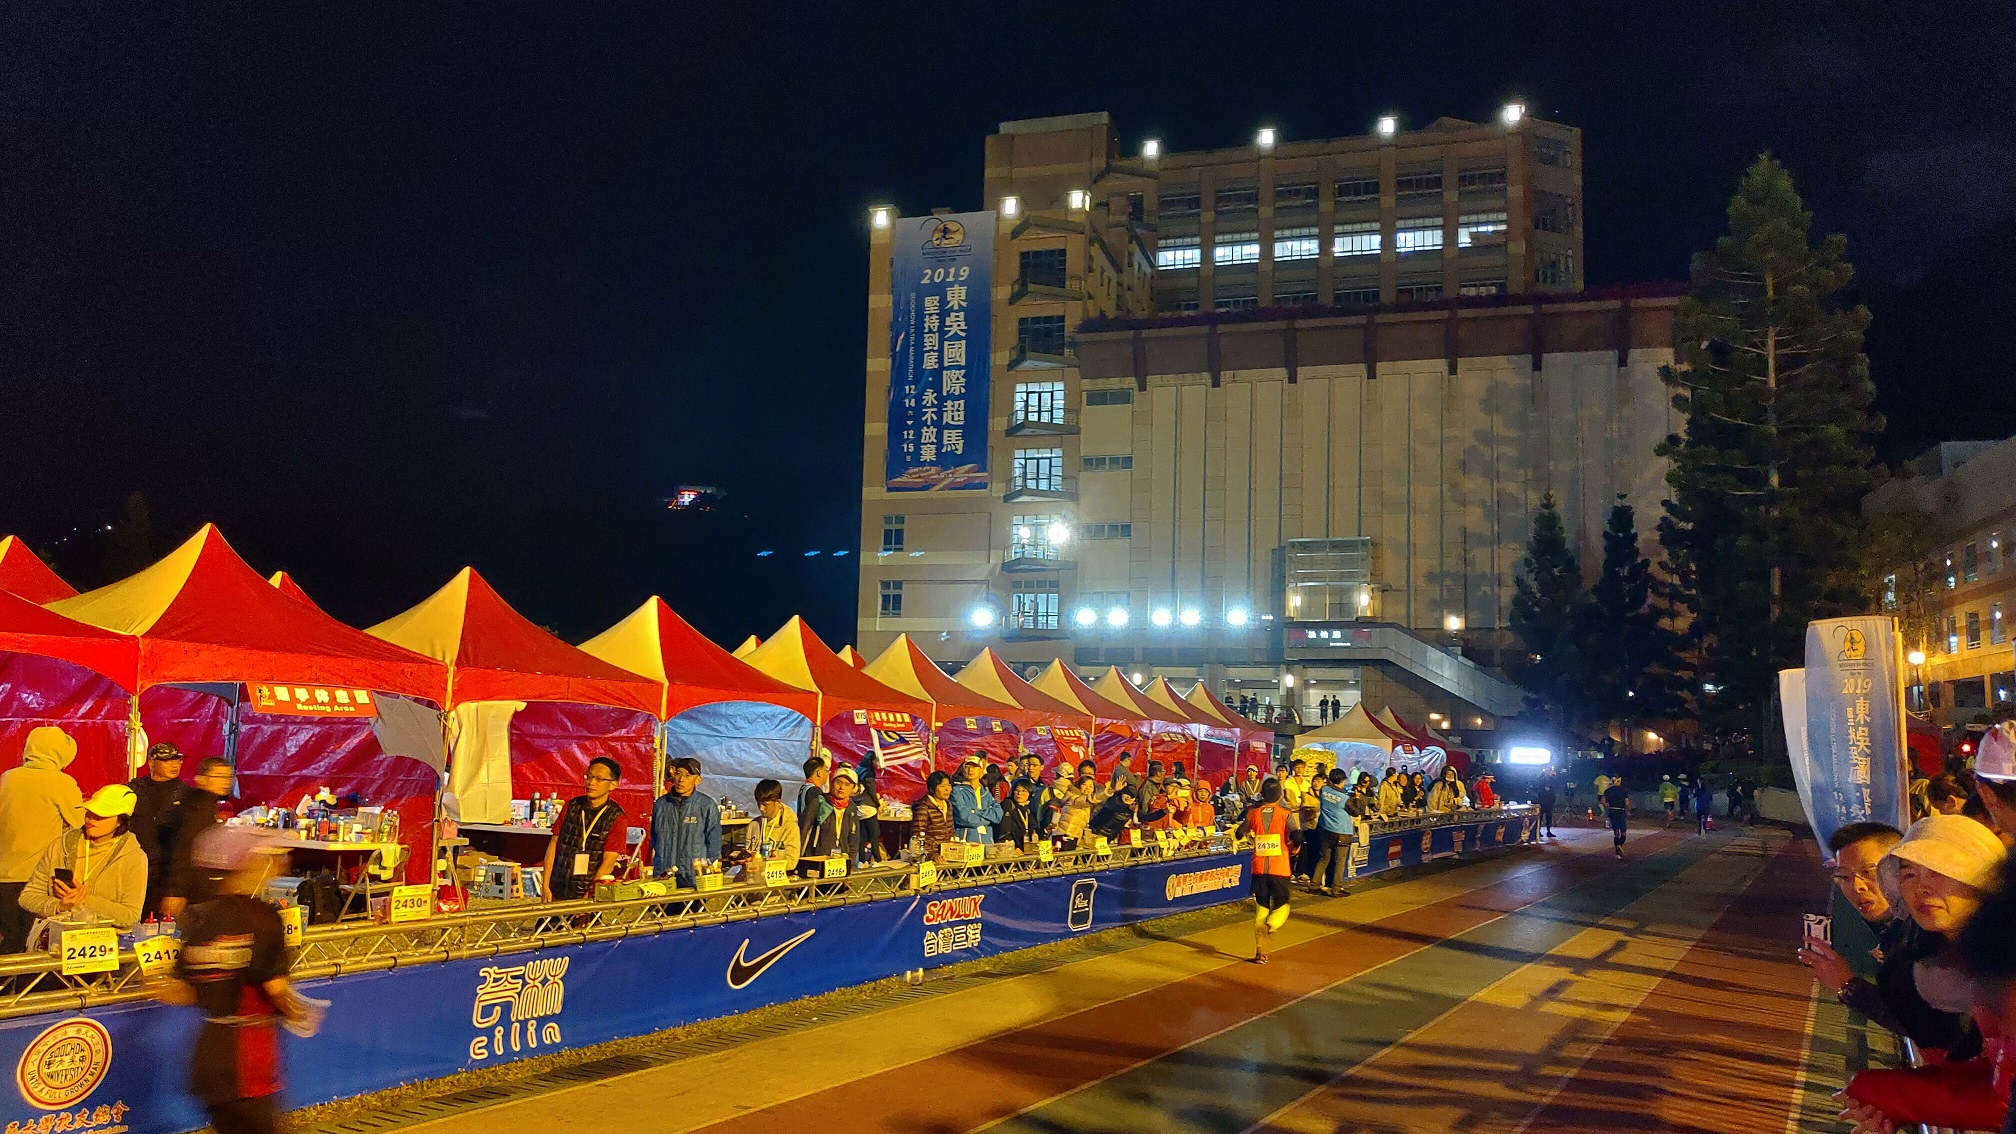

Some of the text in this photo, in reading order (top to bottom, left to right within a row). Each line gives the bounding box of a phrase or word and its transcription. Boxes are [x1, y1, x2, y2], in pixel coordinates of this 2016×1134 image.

[920, 266, 969, 284] 2019
[941, 284, 968, 455] 東吳國際超馬
[1842, 678, 1872, 694] 2019
[767, 870, 782, 879] 2415
[395, 897, 423, 910] 2430
[924, 895, 984, 925] SANLUX
[924, 923, 982, 957] 台灣三洋
[67, 945, 107, 961] 2429
[142, 949, 179, 963] 2412
[470, 1020, 561, 1059] cilin
[45, 1090, 61, 1098] FULL
[64, 1078, 90, 1097] GROWN
[89, 1061, 100, 1077] MAN
